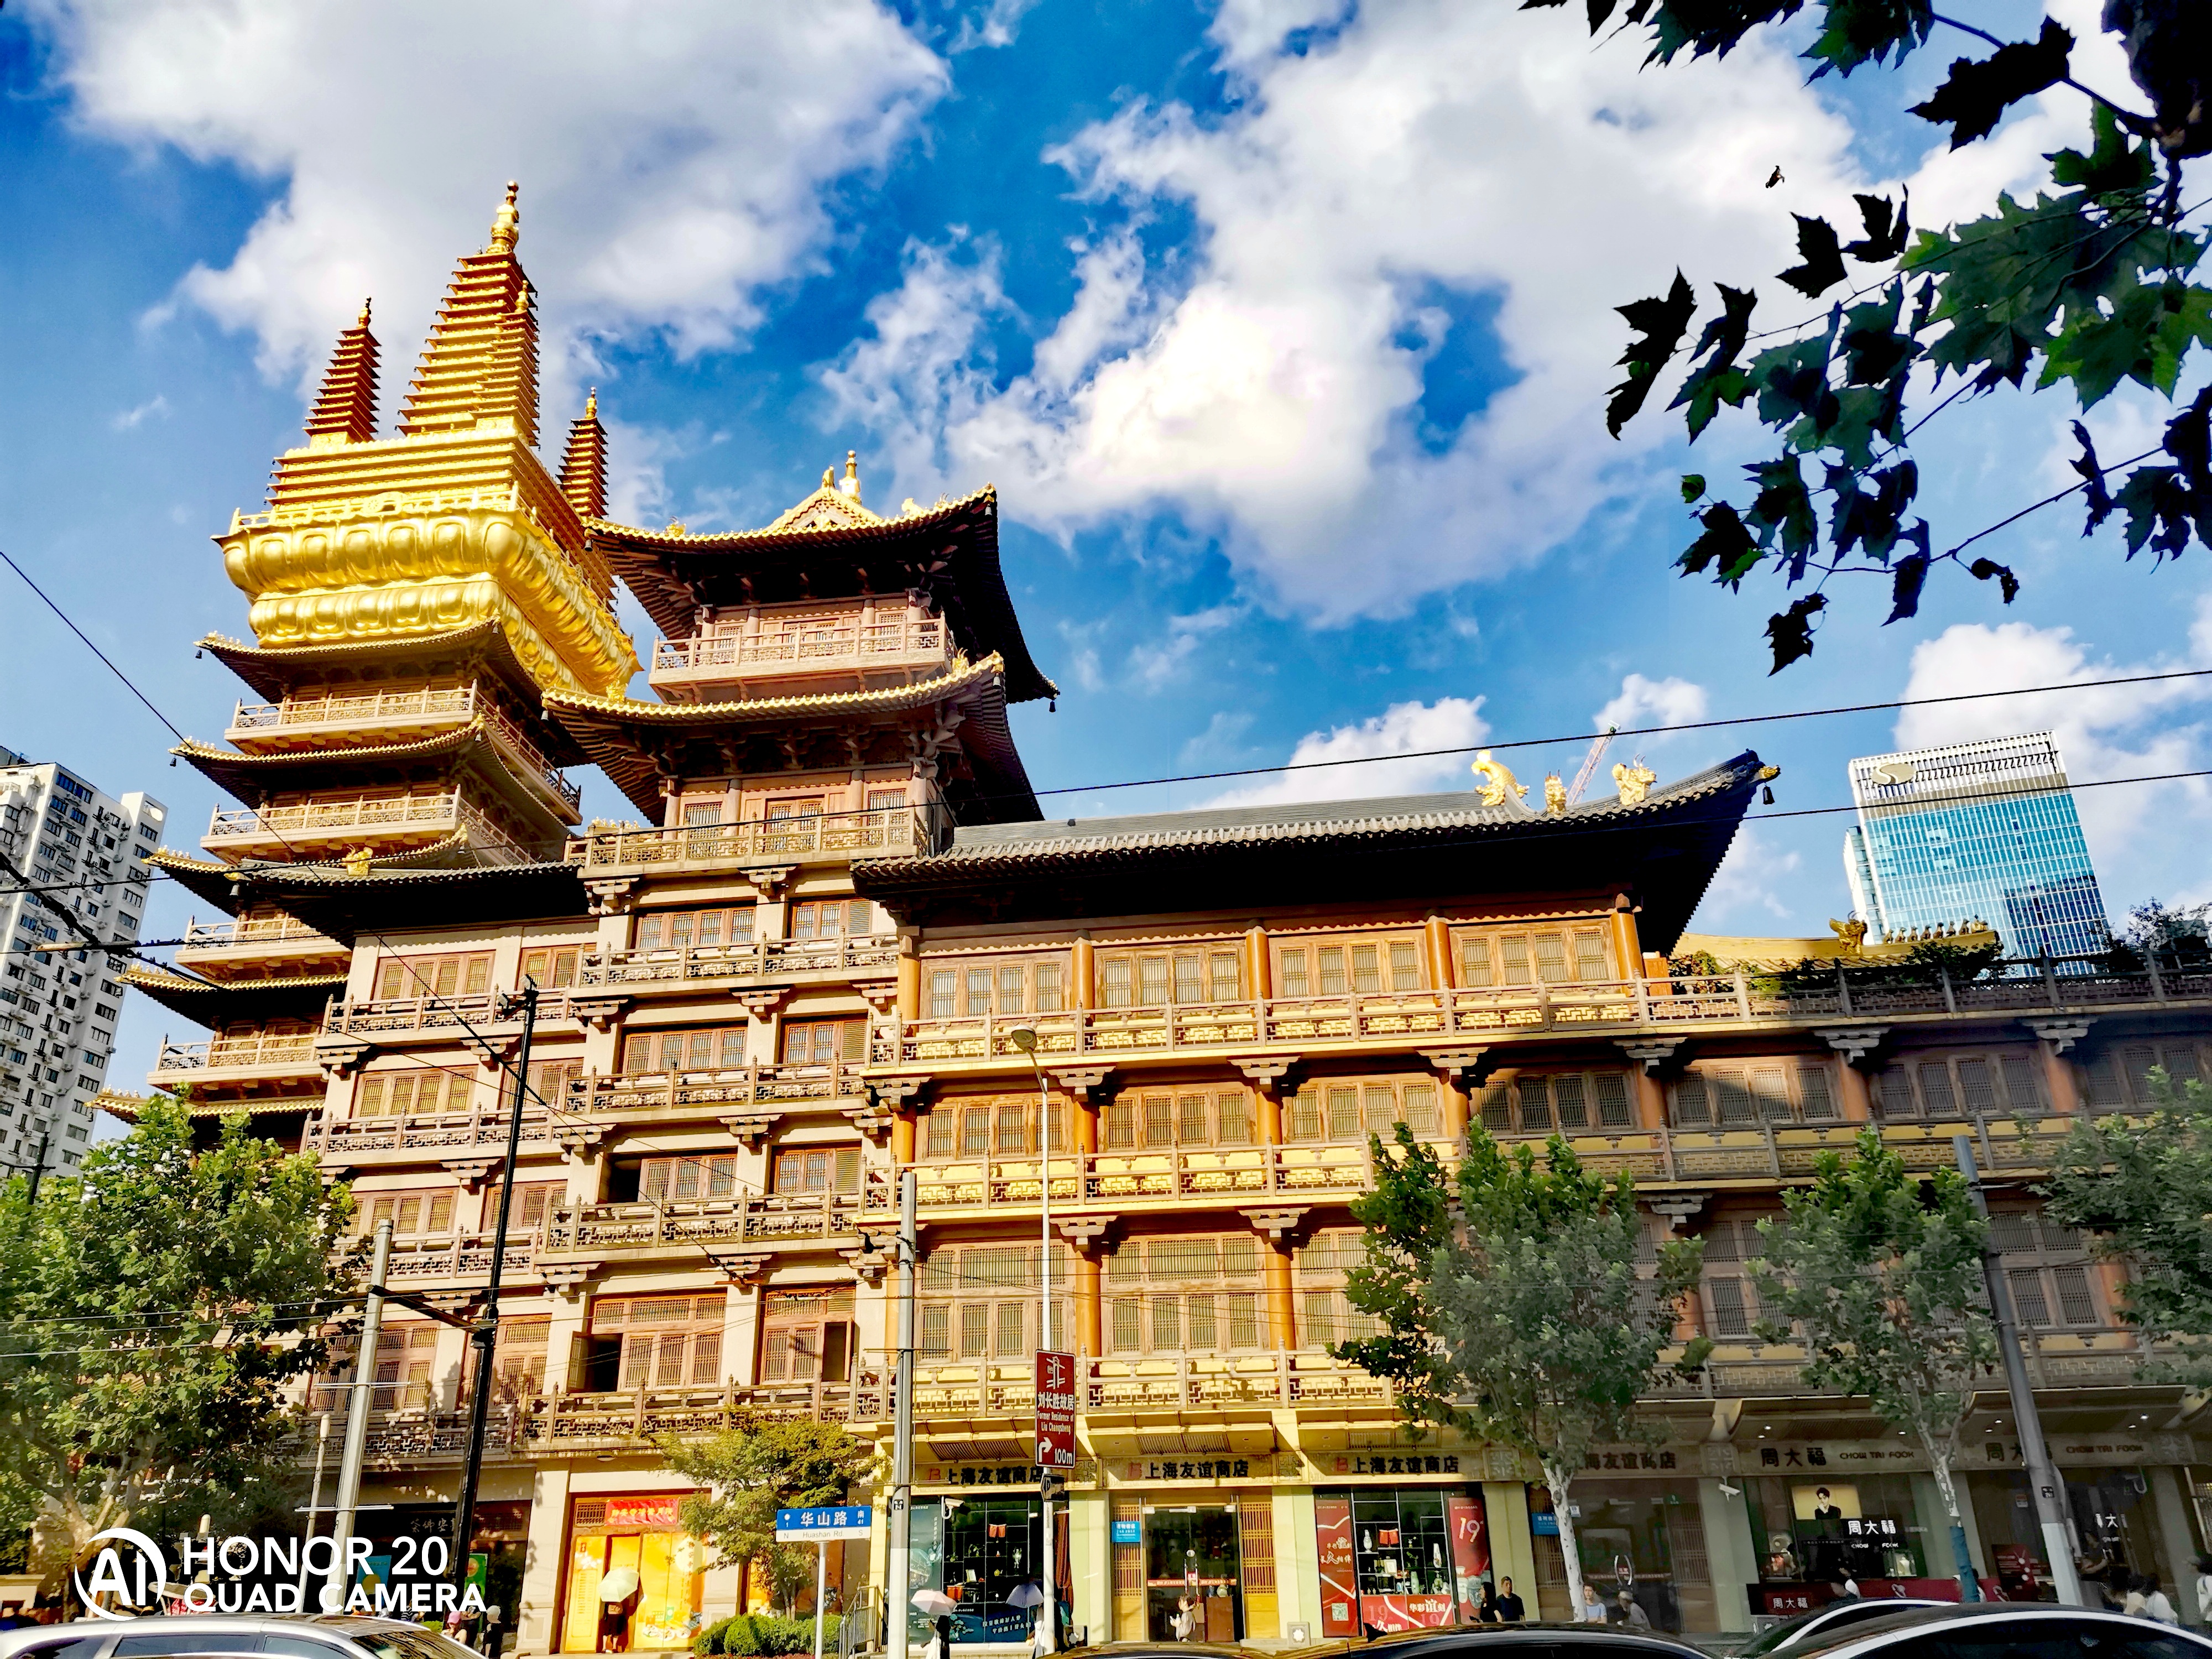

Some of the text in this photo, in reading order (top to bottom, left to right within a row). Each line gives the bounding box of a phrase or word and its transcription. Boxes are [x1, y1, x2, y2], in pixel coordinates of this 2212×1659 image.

[1038, 1391, 1074, 1411] 刘长胜故居
[1037, 1411, 1074, 1422] Former Residence of
[1049, 1422, 1071, 1436] Changsheng
[1055, 1448, 1073, 1464] 100m
[1761, 1447, 1826, 1467] 周大福
[2066, 1446, 2094, 1454] CHOW
[1145, 1459, 1249, 1479] 上海友谊商店
[1352, 1455, 1459, 1474] 上海友谊商店
[800, 1510, 847, 1527] 华山路
[858, 1510, 864, 1518] 南
[1848, 1520, 1896, 1535] 周大福
[1773, 1597, 1808, 1609] 周大福
